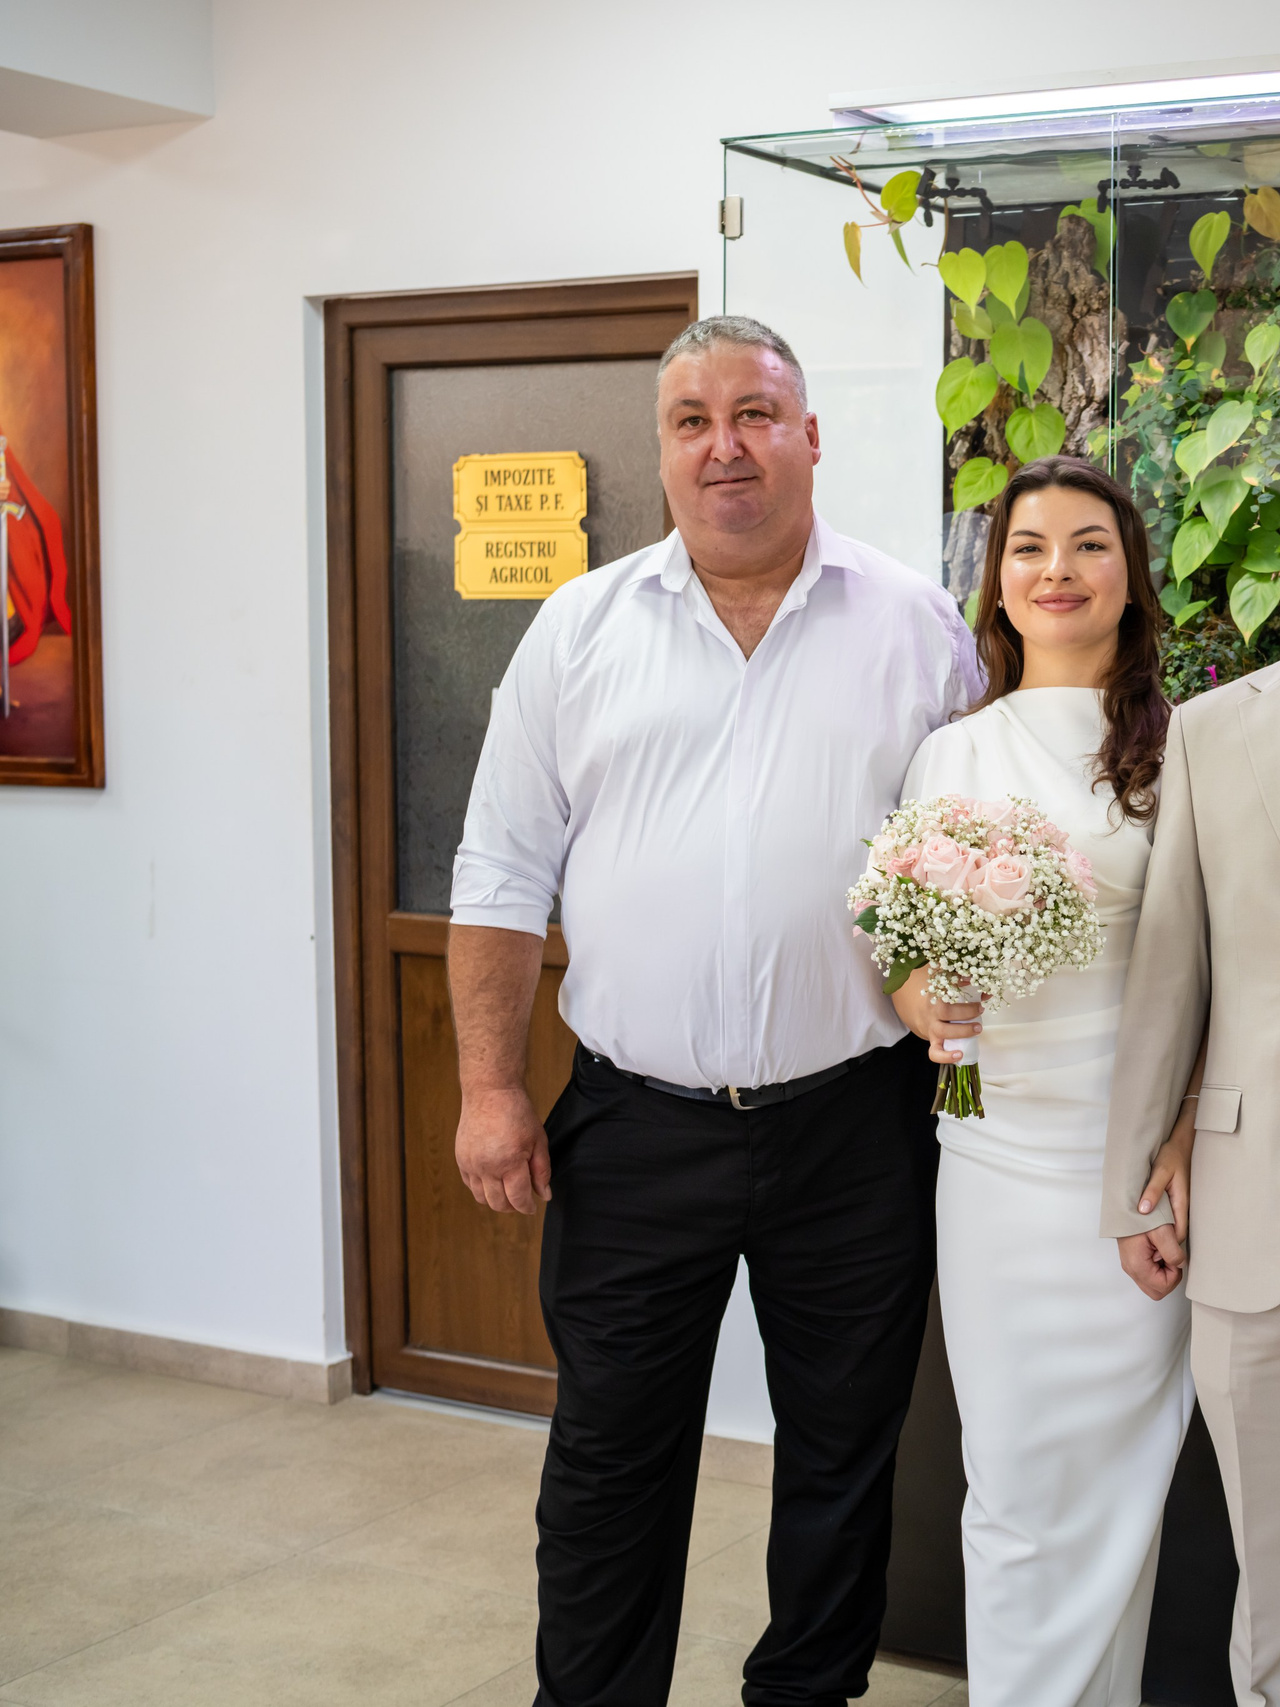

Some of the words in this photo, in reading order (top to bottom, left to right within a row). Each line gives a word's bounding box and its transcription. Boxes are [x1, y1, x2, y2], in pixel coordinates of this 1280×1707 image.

[484, 468, 555, 487] IMPOZITE
[496, 493, 533, 512] TAXE
[485, 541, 557, 559] REGISTRU
[489, 565, 553, 584] AGRICOL
